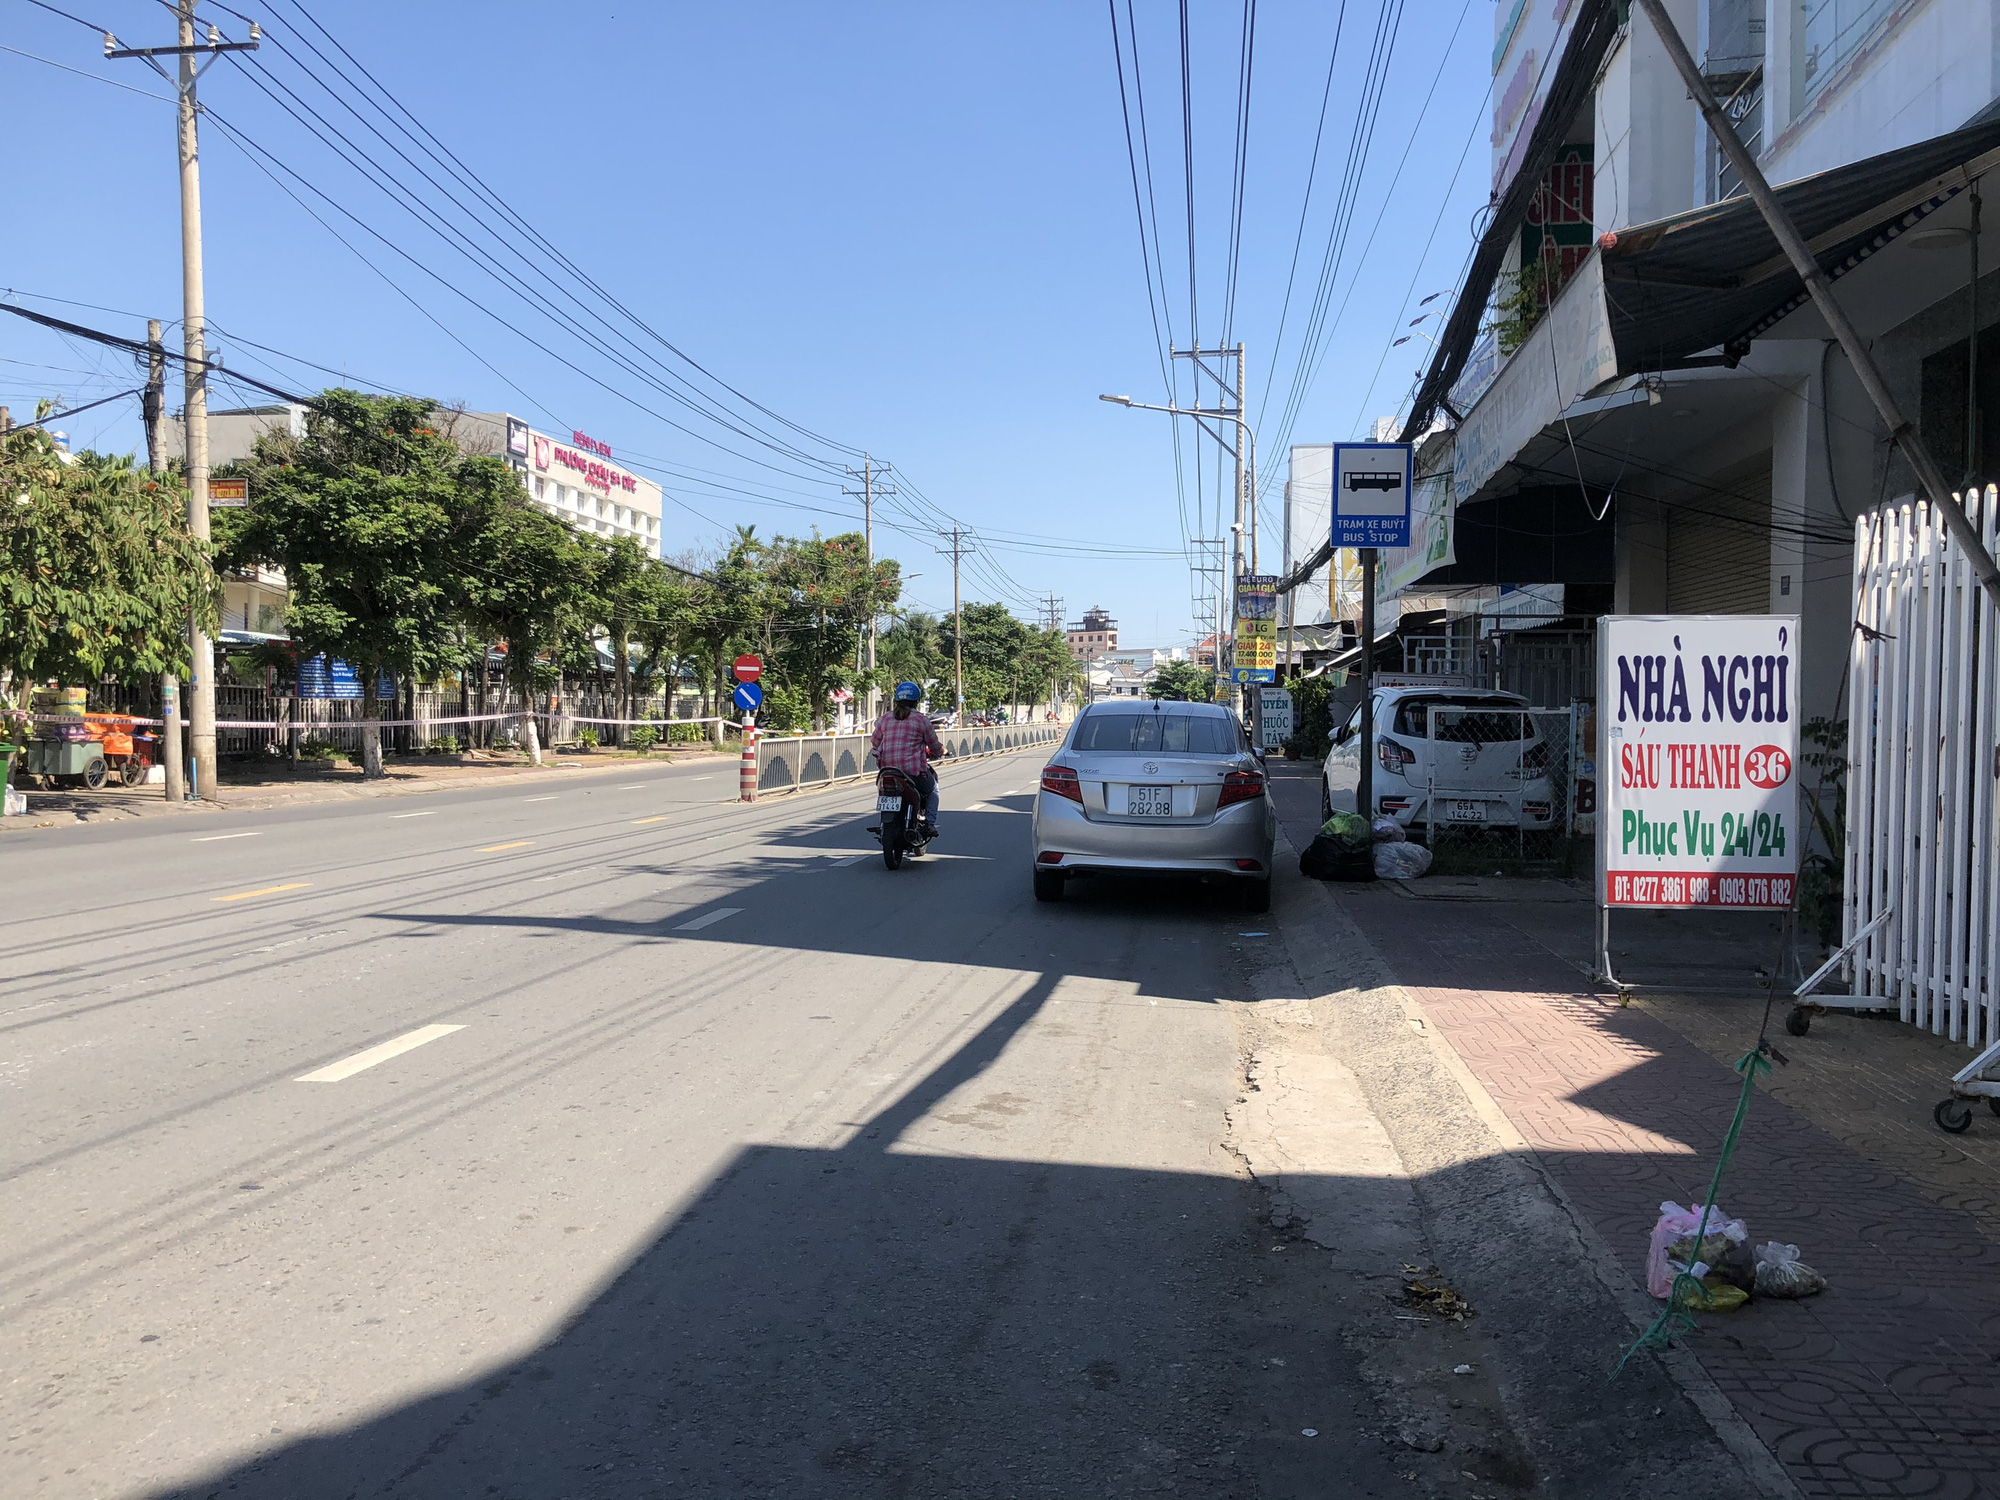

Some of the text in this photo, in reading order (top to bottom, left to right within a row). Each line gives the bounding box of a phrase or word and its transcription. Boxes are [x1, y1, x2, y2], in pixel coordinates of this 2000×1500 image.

[1337, 518, 1406, 530] TRẠM XE BUÝT
[1343, 533, 1398, 542] BUS STOP
[1255, 623, 1268, 632] LG
[1618, 626, 1789, 723] NHÀ NGHỈ
[1263, 711, 1289, 728] HUỐC
[1621, 727, 1786, 789] SÁU THANH 36
[1138, 788, 1162, 801] 51F
[1130, 801, 1170, 815] 282.88
[1451, 810, 1482, 819] 144.22
[1622, 810, 1785, 862] Phục Vụ 24/24
[1615, 876, 1630, 901] ĐT:
[1633, 876, 1658, 902] 0277
[1661, 877, 1686, 902] 3861
[1690, 878, 1709, 903] 988
[1720, 878, 1745, 904] 0903
[1749, 878, 1768, 904] 976
[1771, 879, 1791, 904] 882
